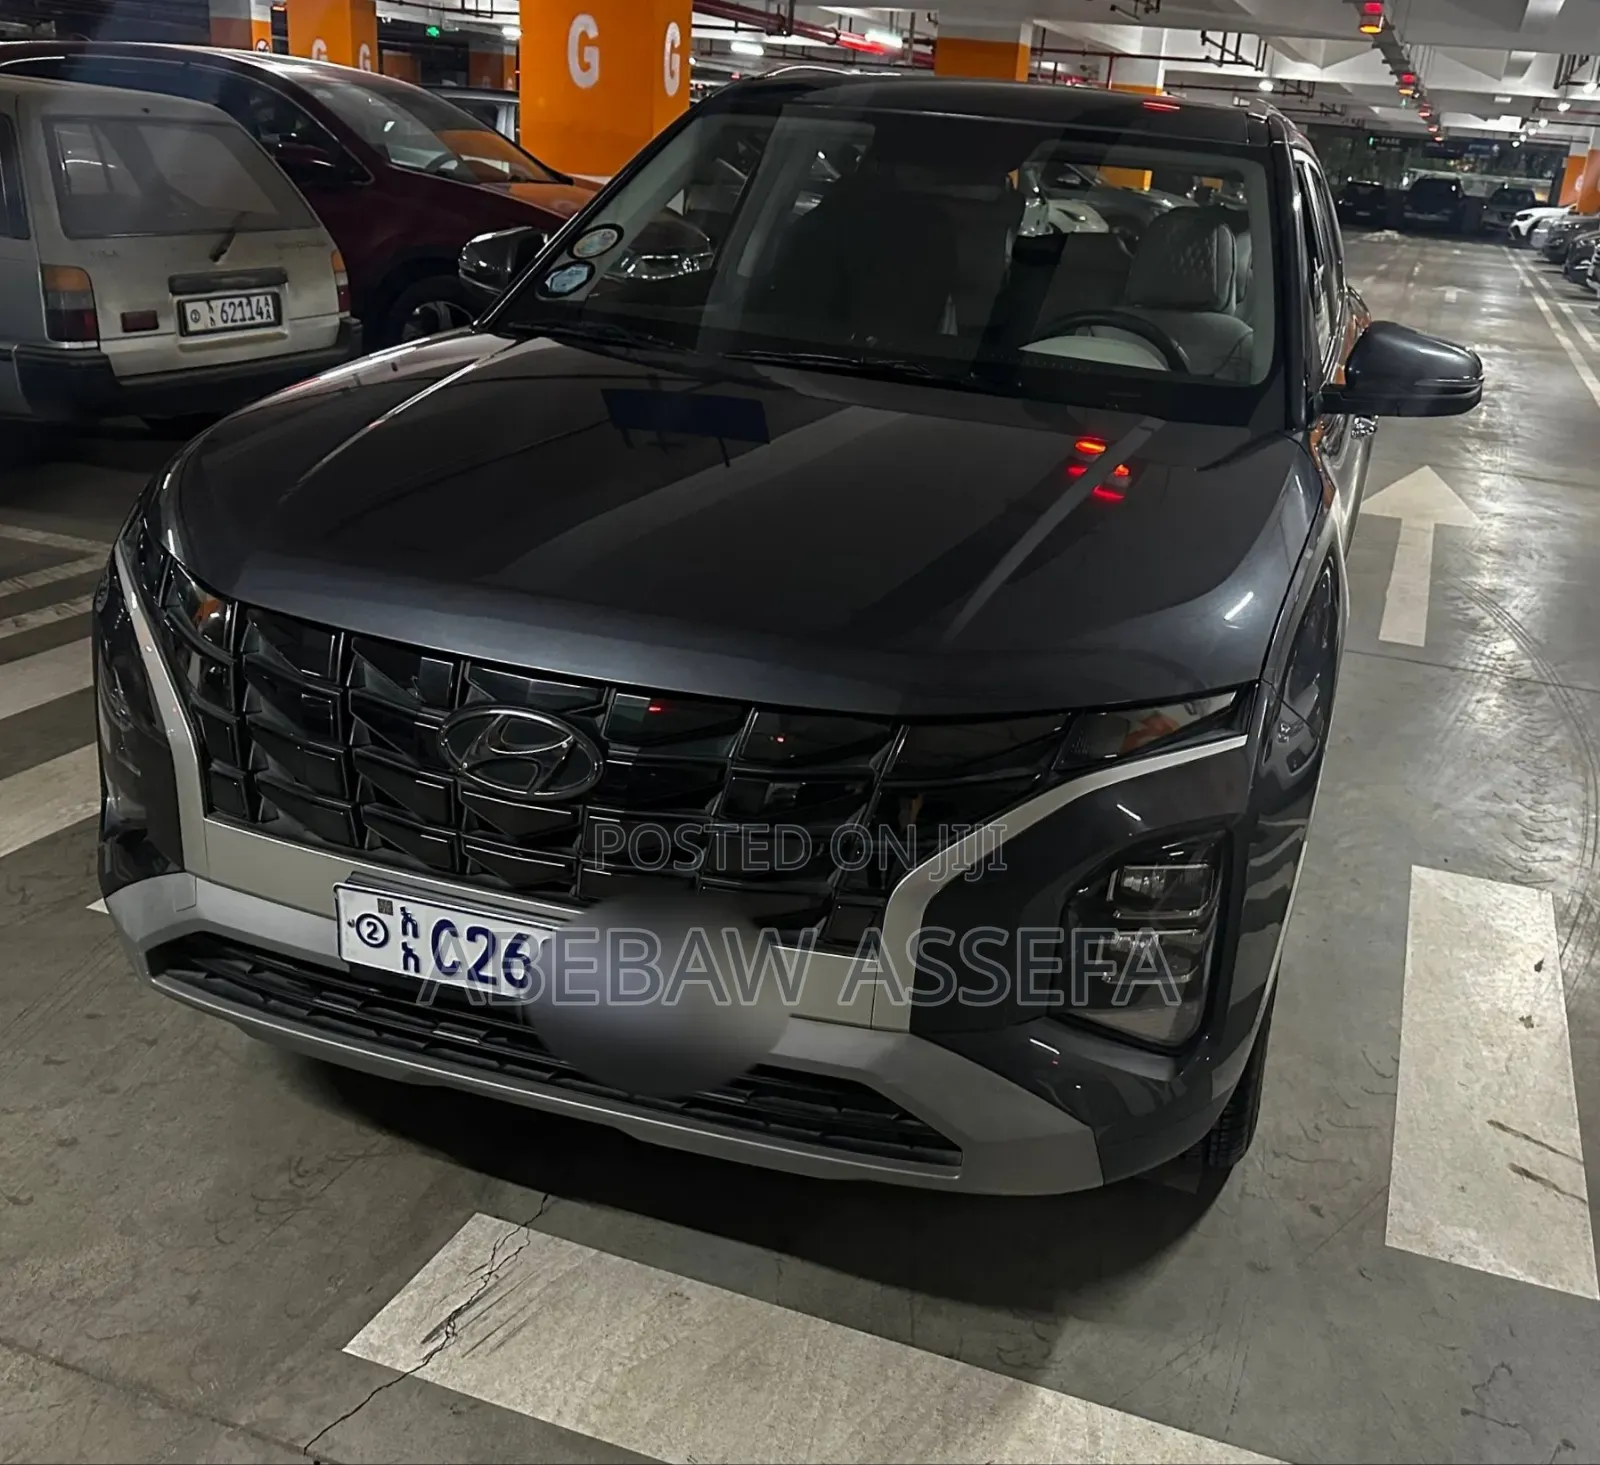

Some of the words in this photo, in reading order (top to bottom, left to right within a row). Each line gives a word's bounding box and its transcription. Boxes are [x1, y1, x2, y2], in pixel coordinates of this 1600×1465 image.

[568, 13, 599, 88] G
[664, 21, 680, 96] G
[220, 299, 264, 324] 62114
[431, 918, 537, 989] C26
